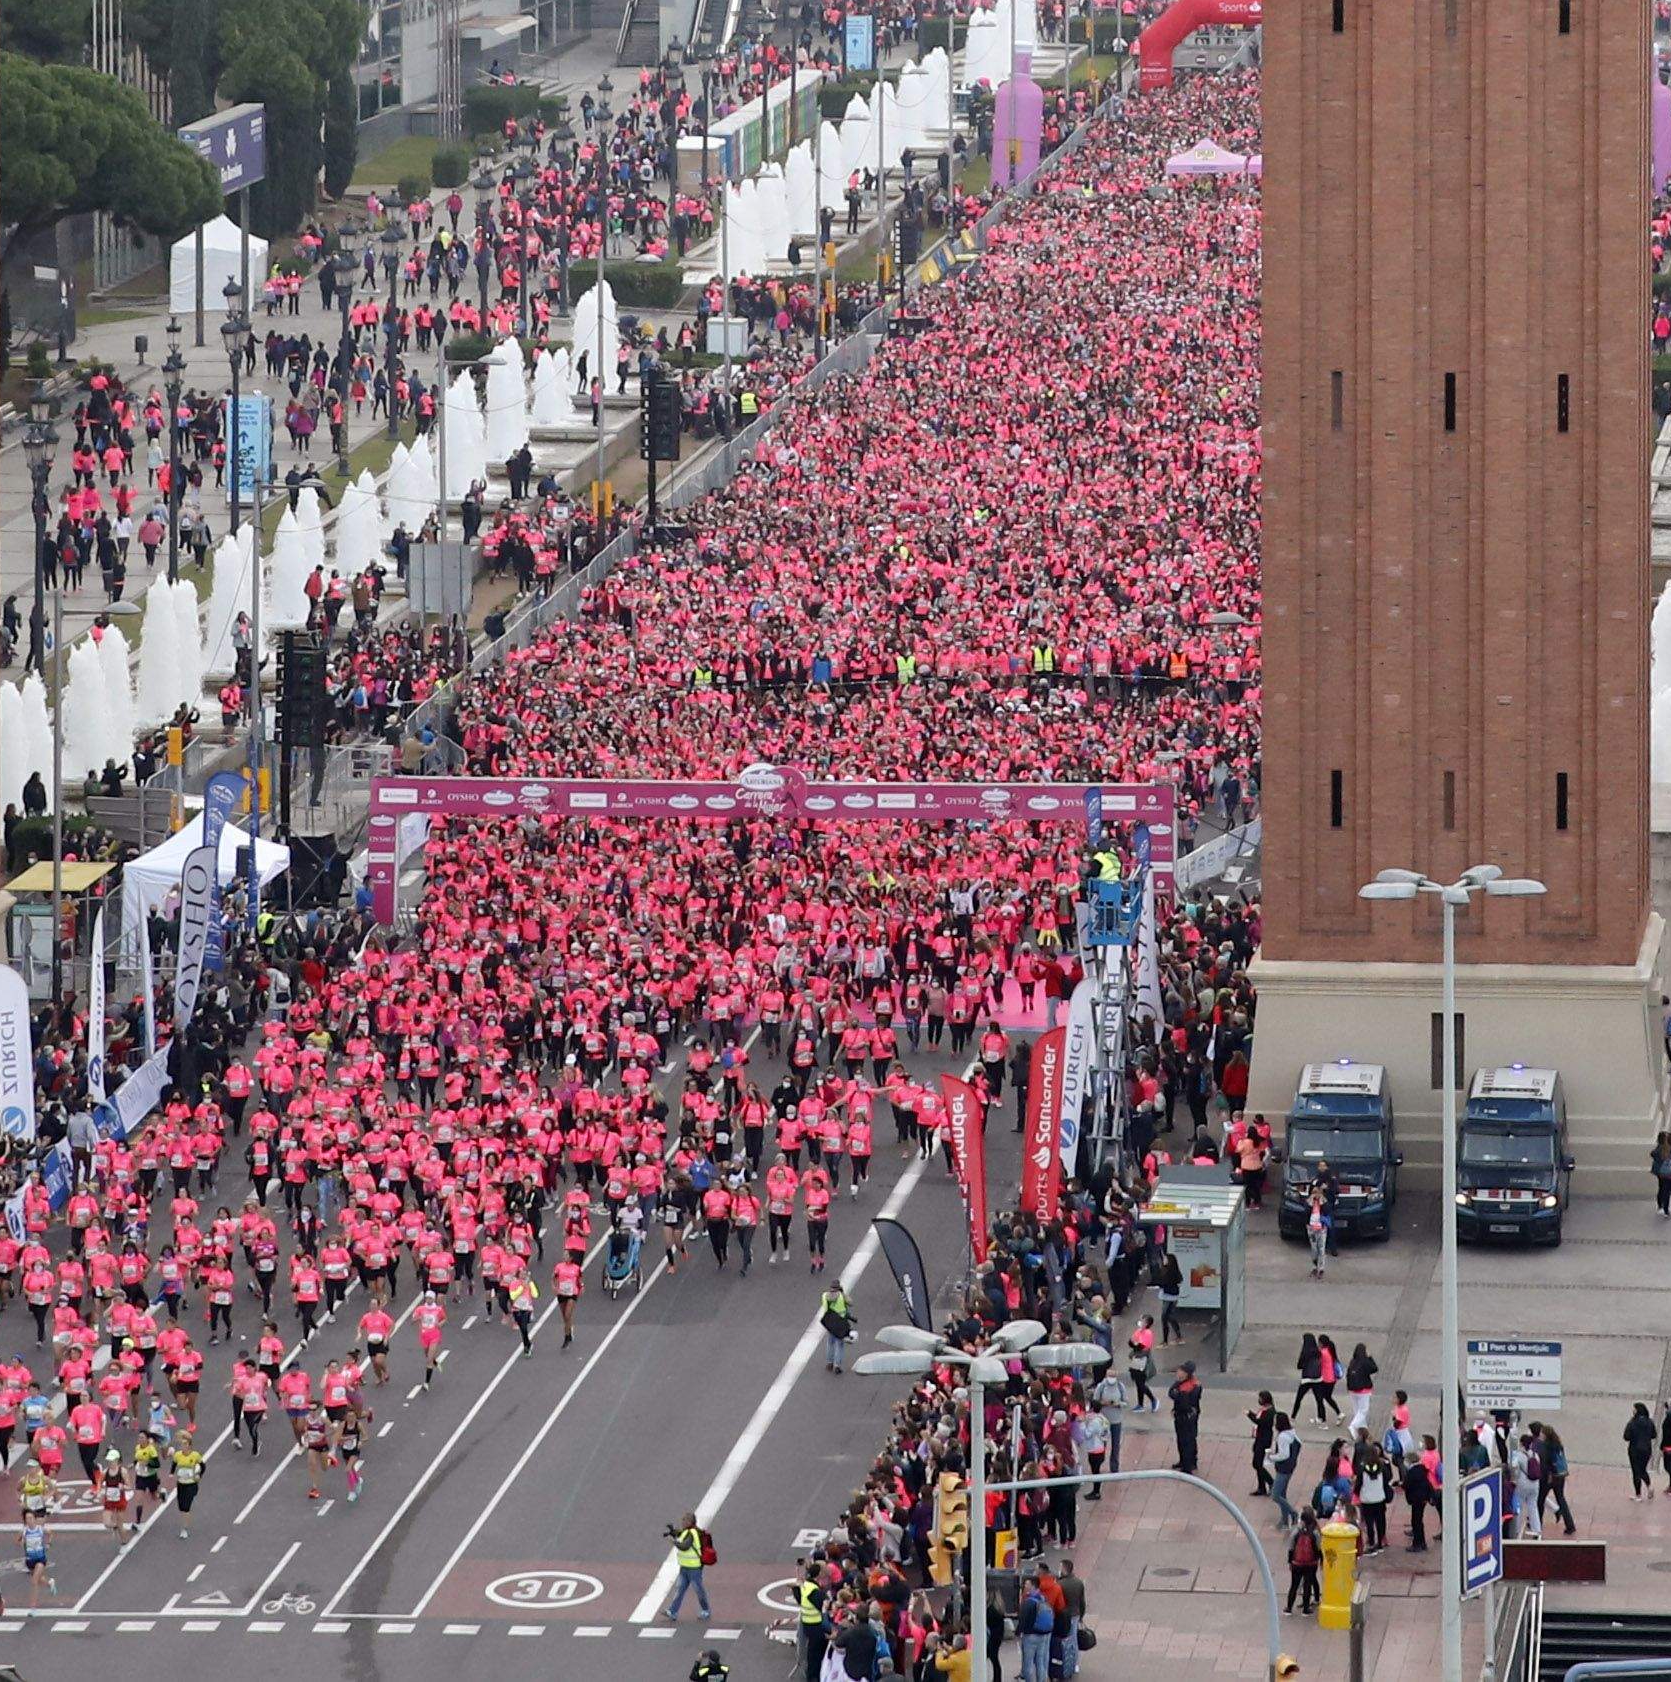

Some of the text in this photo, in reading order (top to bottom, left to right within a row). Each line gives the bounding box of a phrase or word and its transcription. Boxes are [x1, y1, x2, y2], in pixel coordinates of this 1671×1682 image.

[1218, 2, 1249, 13] Sports
[447, 793, 479, 801] OYSHO
[945, 797, 977, 806] OYSHO
[1062, 1024, 1085, 1108] ZURICH
[1036, 1043, 1057, 1143] Santander
[1490, 1344, 1506, 1352] Parc
[1507, 1344, 1517, 1352] de
[1479, 1359, 1507, 1367] Escales
[1467, 1483, 1492, 1561] P
[512, 1579, 578, 1599] 30
